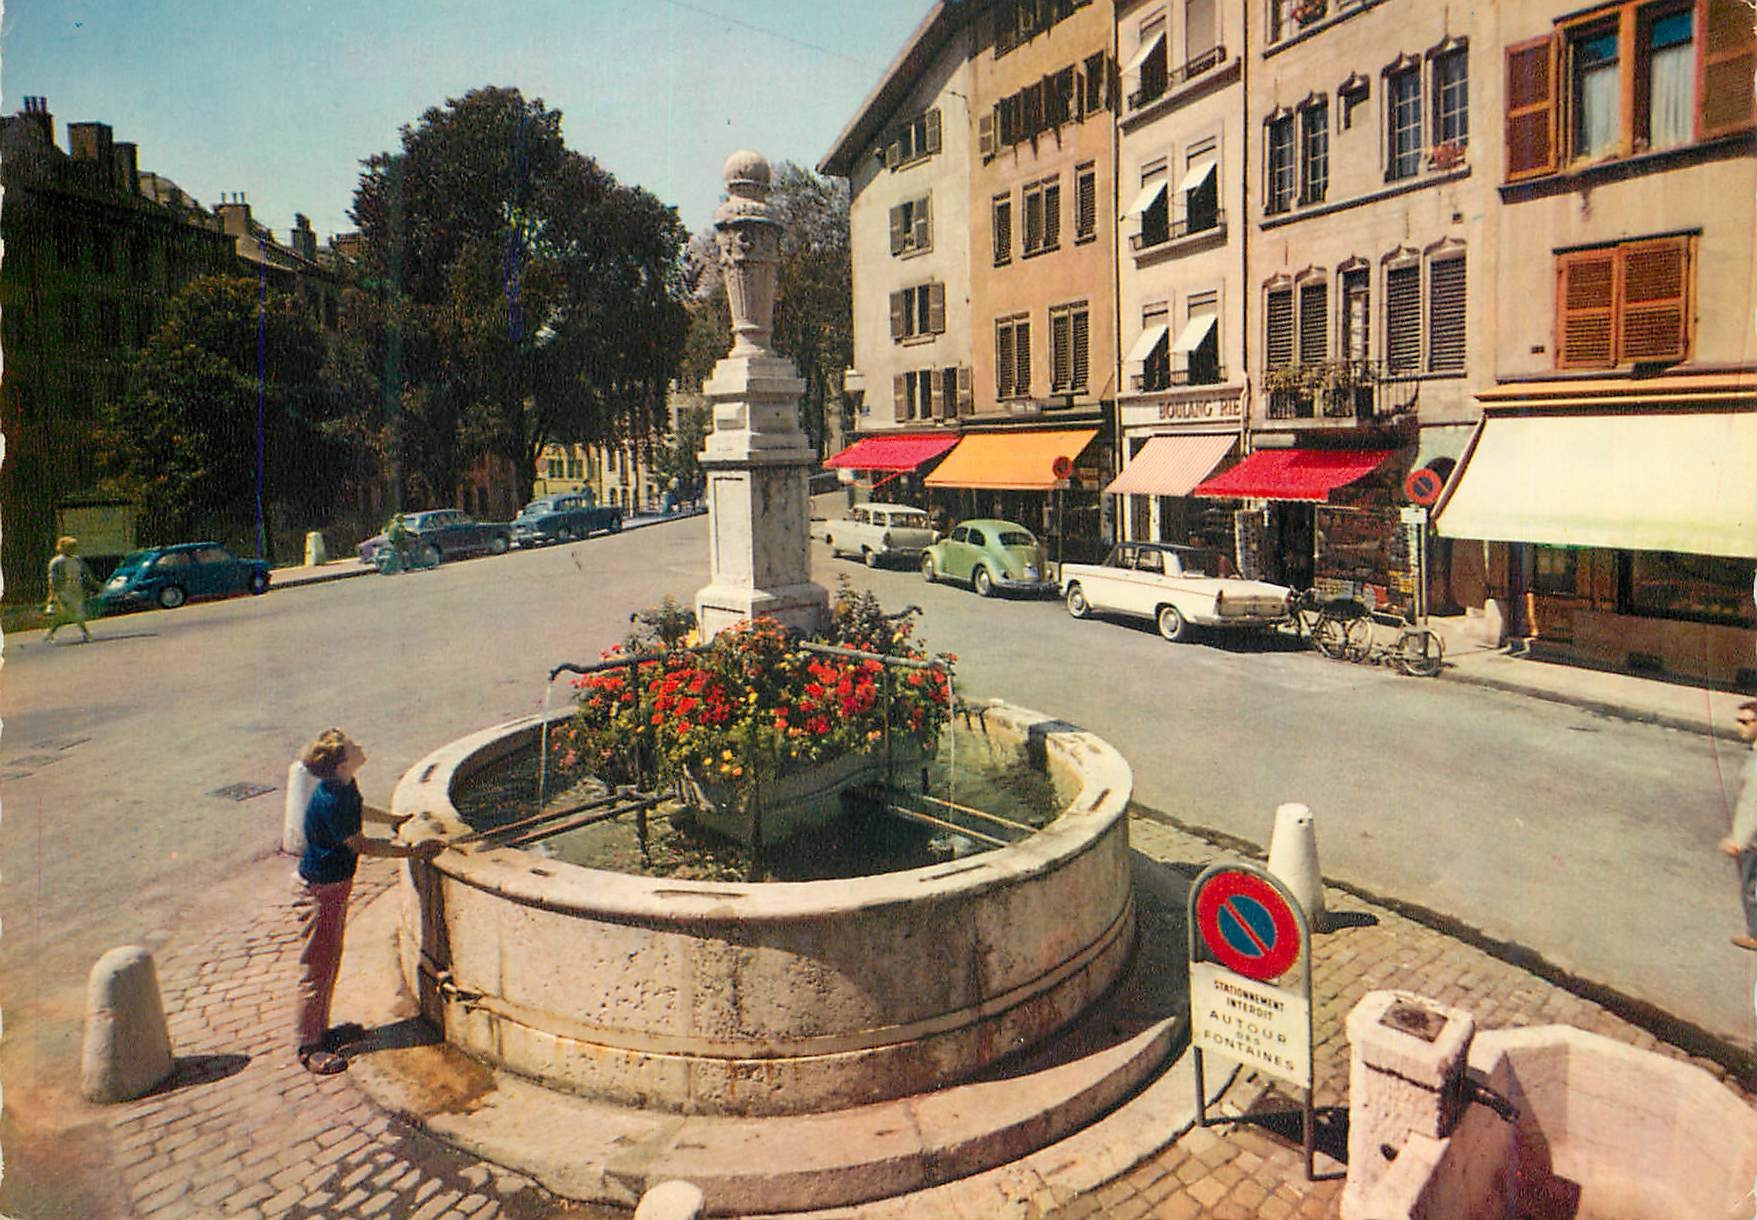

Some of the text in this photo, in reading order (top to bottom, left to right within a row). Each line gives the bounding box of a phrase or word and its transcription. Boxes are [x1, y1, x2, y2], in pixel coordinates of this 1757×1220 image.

[1214, 980, 1284, 1012] STATIONNEMENT
[1226, 998, 1273, 1021] INTERDIT
[1209, 1010, 1287, 1044] AUTOUR
[1203, 1030, 1294, 1071] FONTAINES
